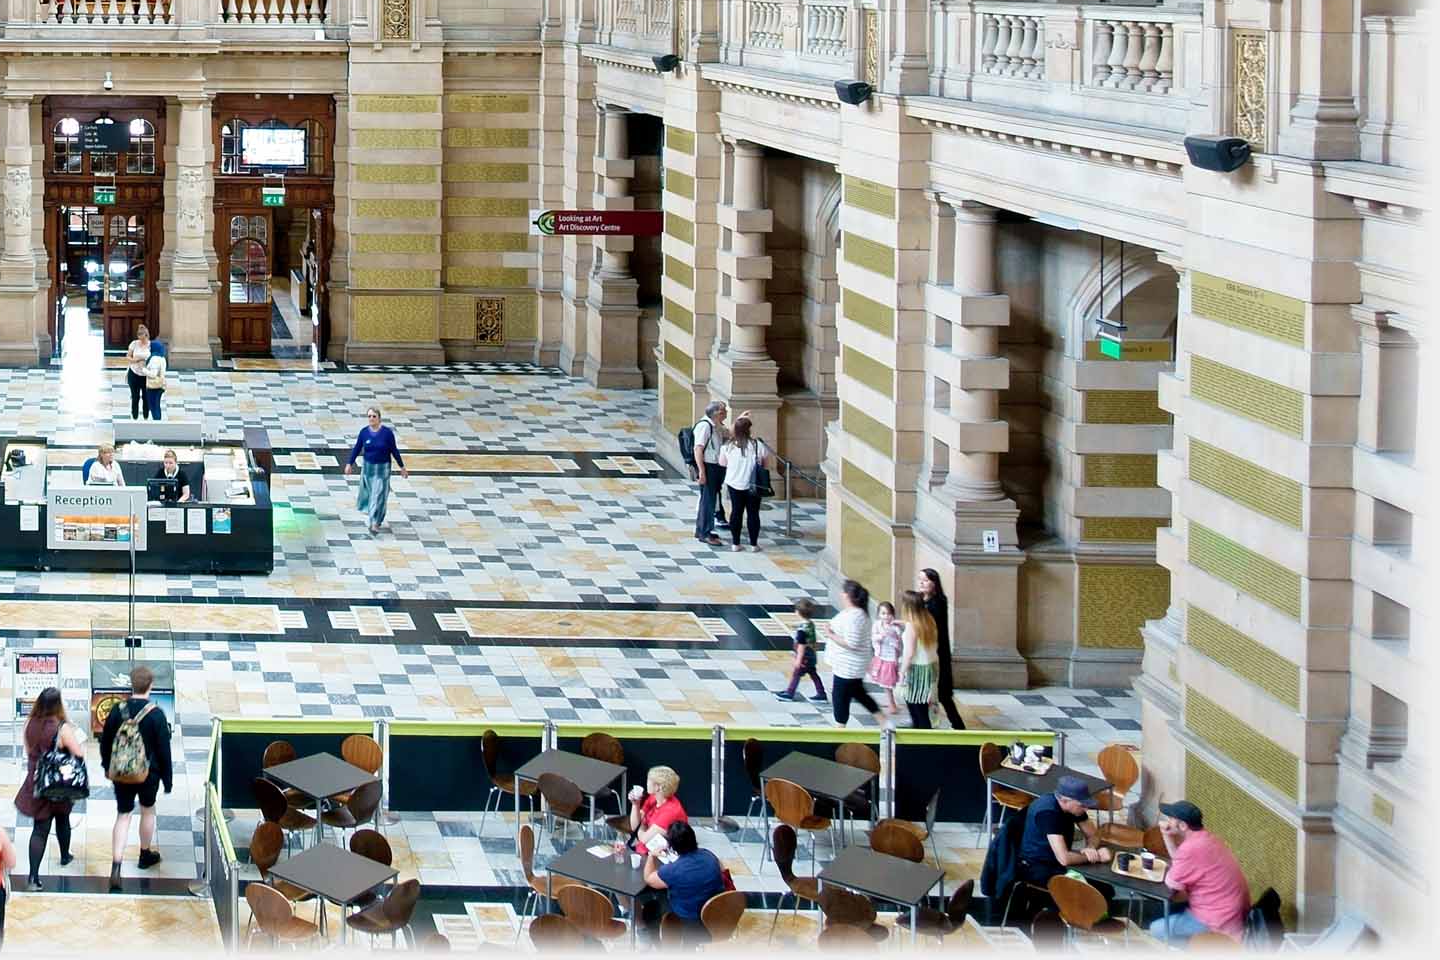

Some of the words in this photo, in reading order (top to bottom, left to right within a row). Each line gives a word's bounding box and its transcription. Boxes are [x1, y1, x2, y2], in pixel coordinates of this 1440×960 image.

[558, 215, 584, 223] Looking
[570, 224, 600, 232] Discovery
[55, 495, 112, 507] Reception
